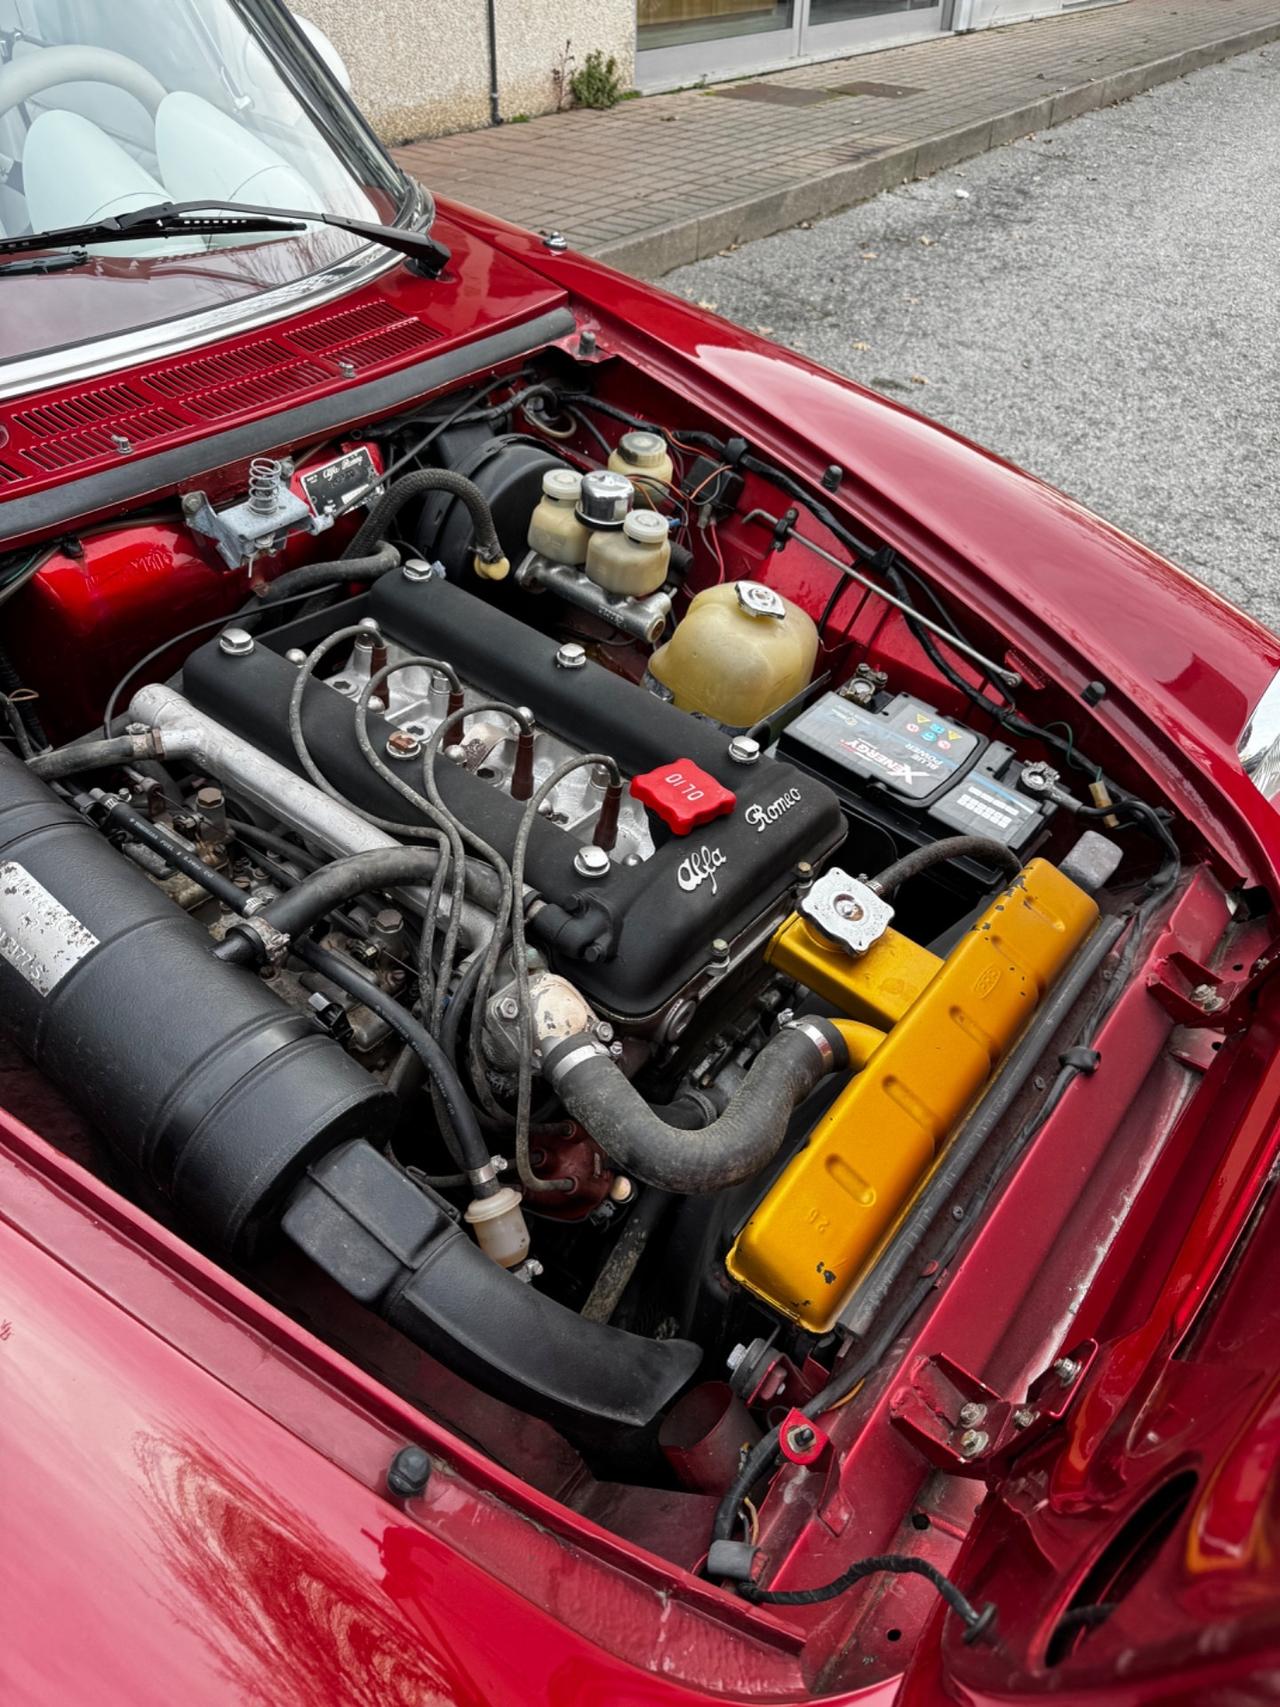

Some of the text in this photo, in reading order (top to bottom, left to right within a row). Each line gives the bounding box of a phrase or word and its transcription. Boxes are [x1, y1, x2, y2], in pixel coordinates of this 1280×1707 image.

[905, 743, 943, 766] POWER
[911, 753, 939, 770] BLUE
[665, 773, 704, 801] OLIO
[677, 787, 802, 895] Alfa Romeo
